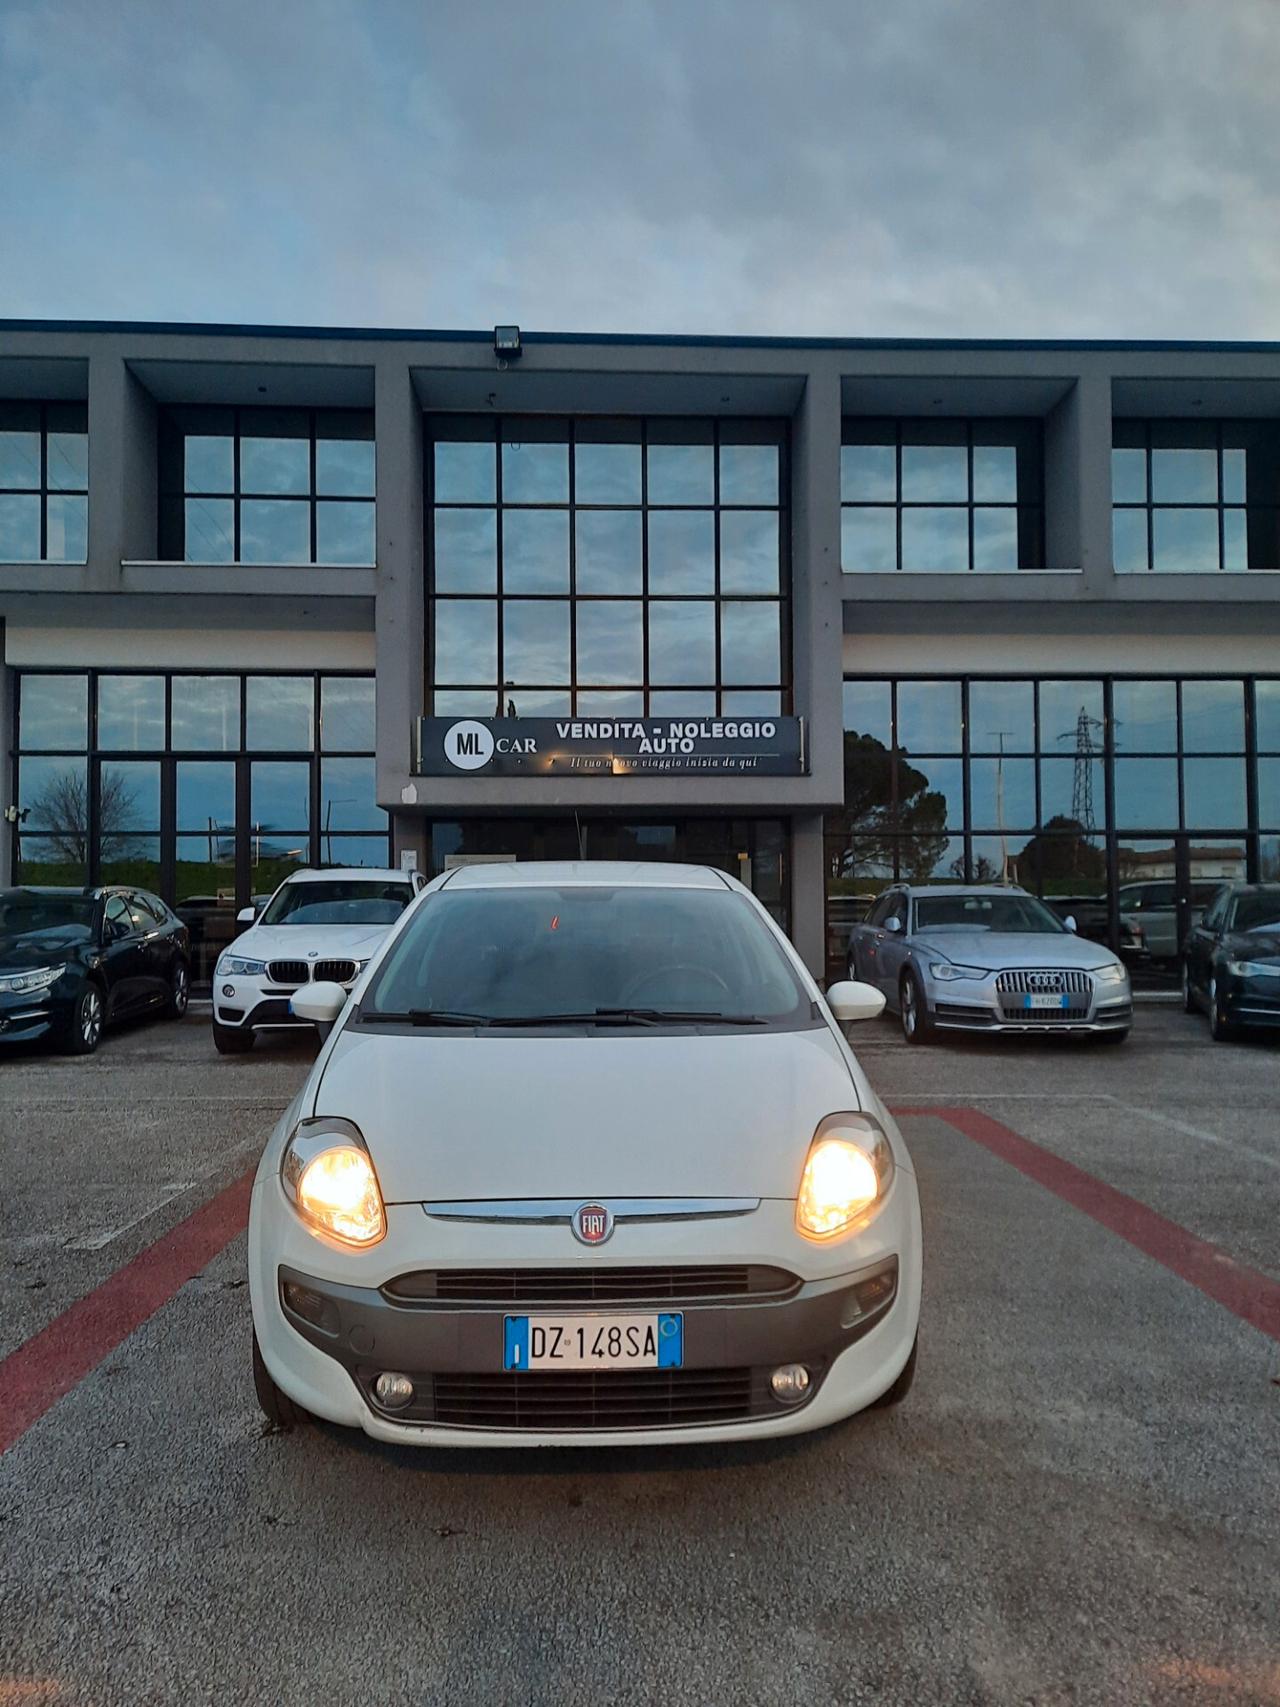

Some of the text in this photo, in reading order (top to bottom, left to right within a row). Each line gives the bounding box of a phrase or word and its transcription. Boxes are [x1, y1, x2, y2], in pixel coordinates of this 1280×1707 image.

[556, 723, 646, 738] VENDITA
[670, 722, 776, 738] NOLEGGIO
[456, 733, 484, 755] ML
[496, 738, 537, 753] CAR
[639, 738, 695, 753] AUTO
[571, 756, 757, 770] Il tuo novo viaggio inizia da qui
[582, 1214, 605, 1235] FIAT
